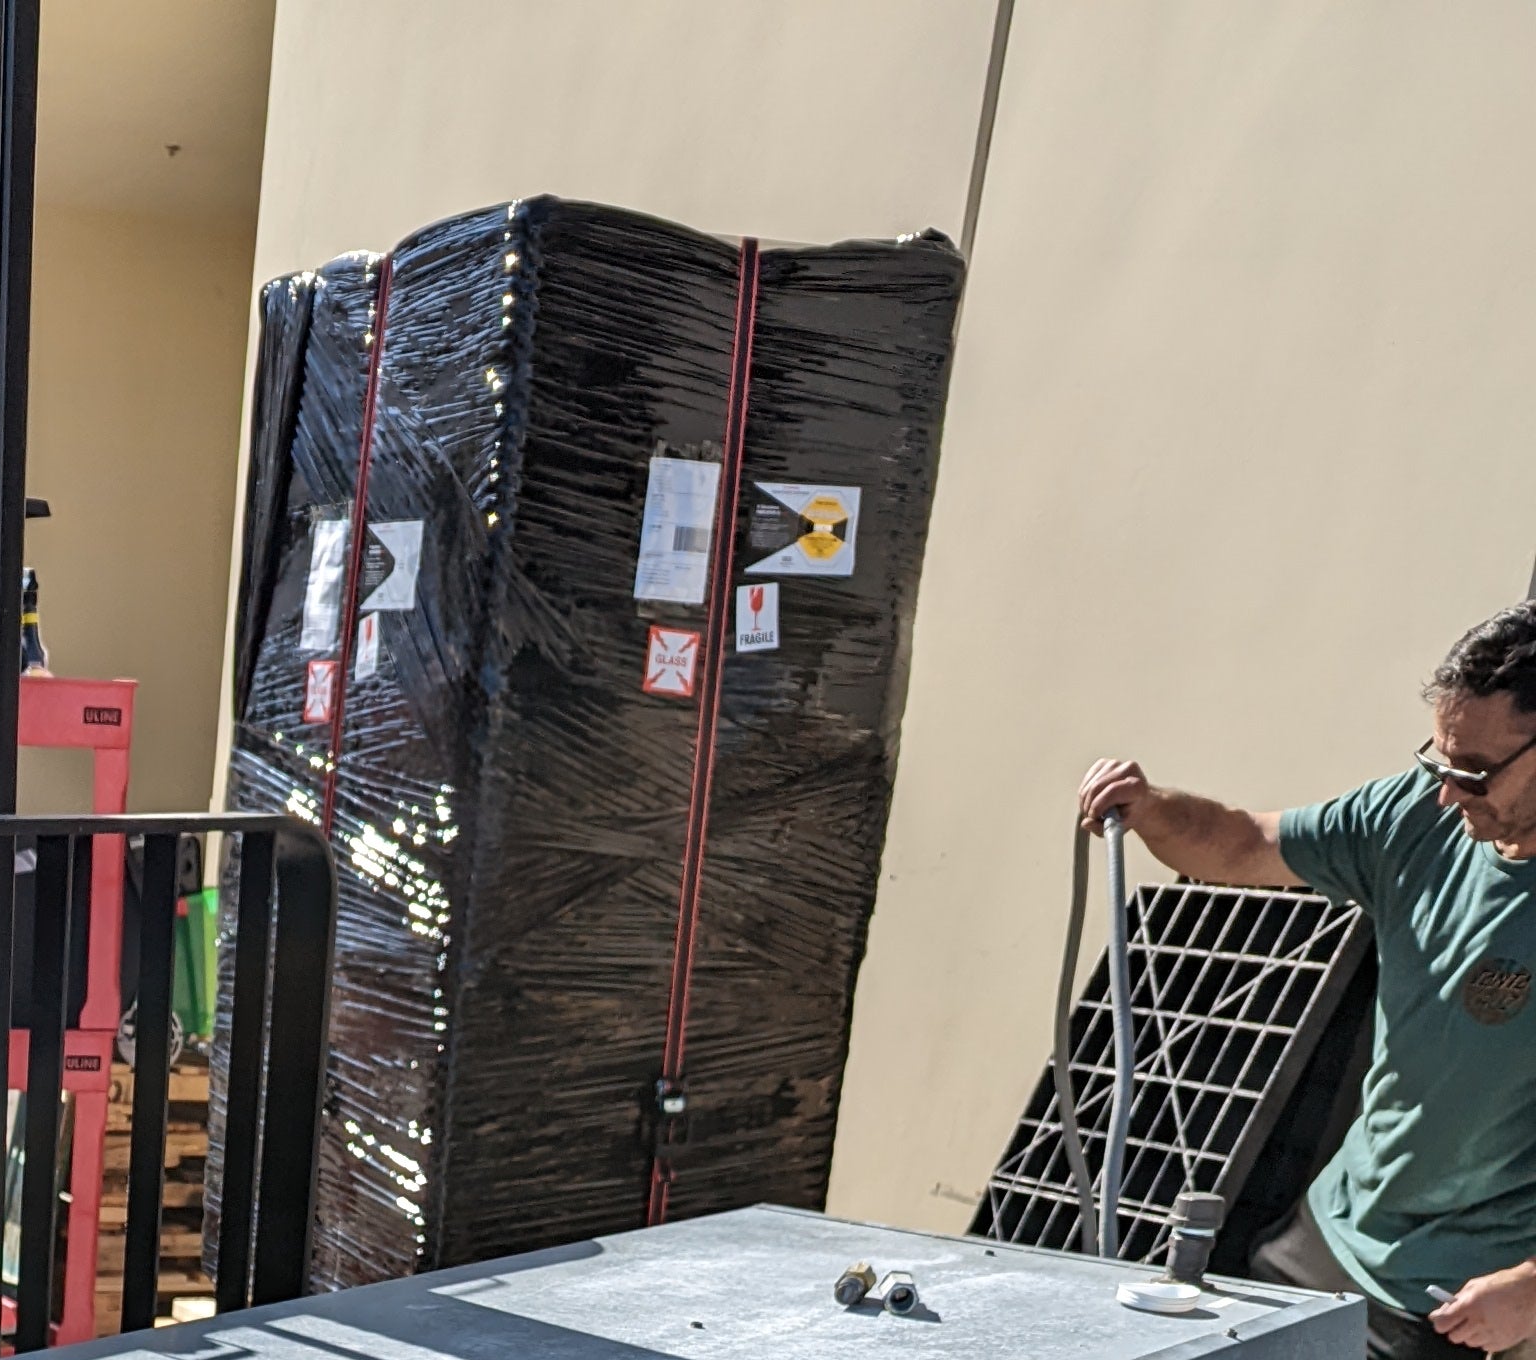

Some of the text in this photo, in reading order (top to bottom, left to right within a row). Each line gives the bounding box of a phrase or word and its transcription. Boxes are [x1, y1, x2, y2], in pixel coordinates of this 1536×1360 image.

[739, 631, 774, 646] FRAGILE
[656, 653, 687, 667] GLASS
[84, 708, 121, 724] ULINE
[66, 1057, 100, 1070] ULINE
